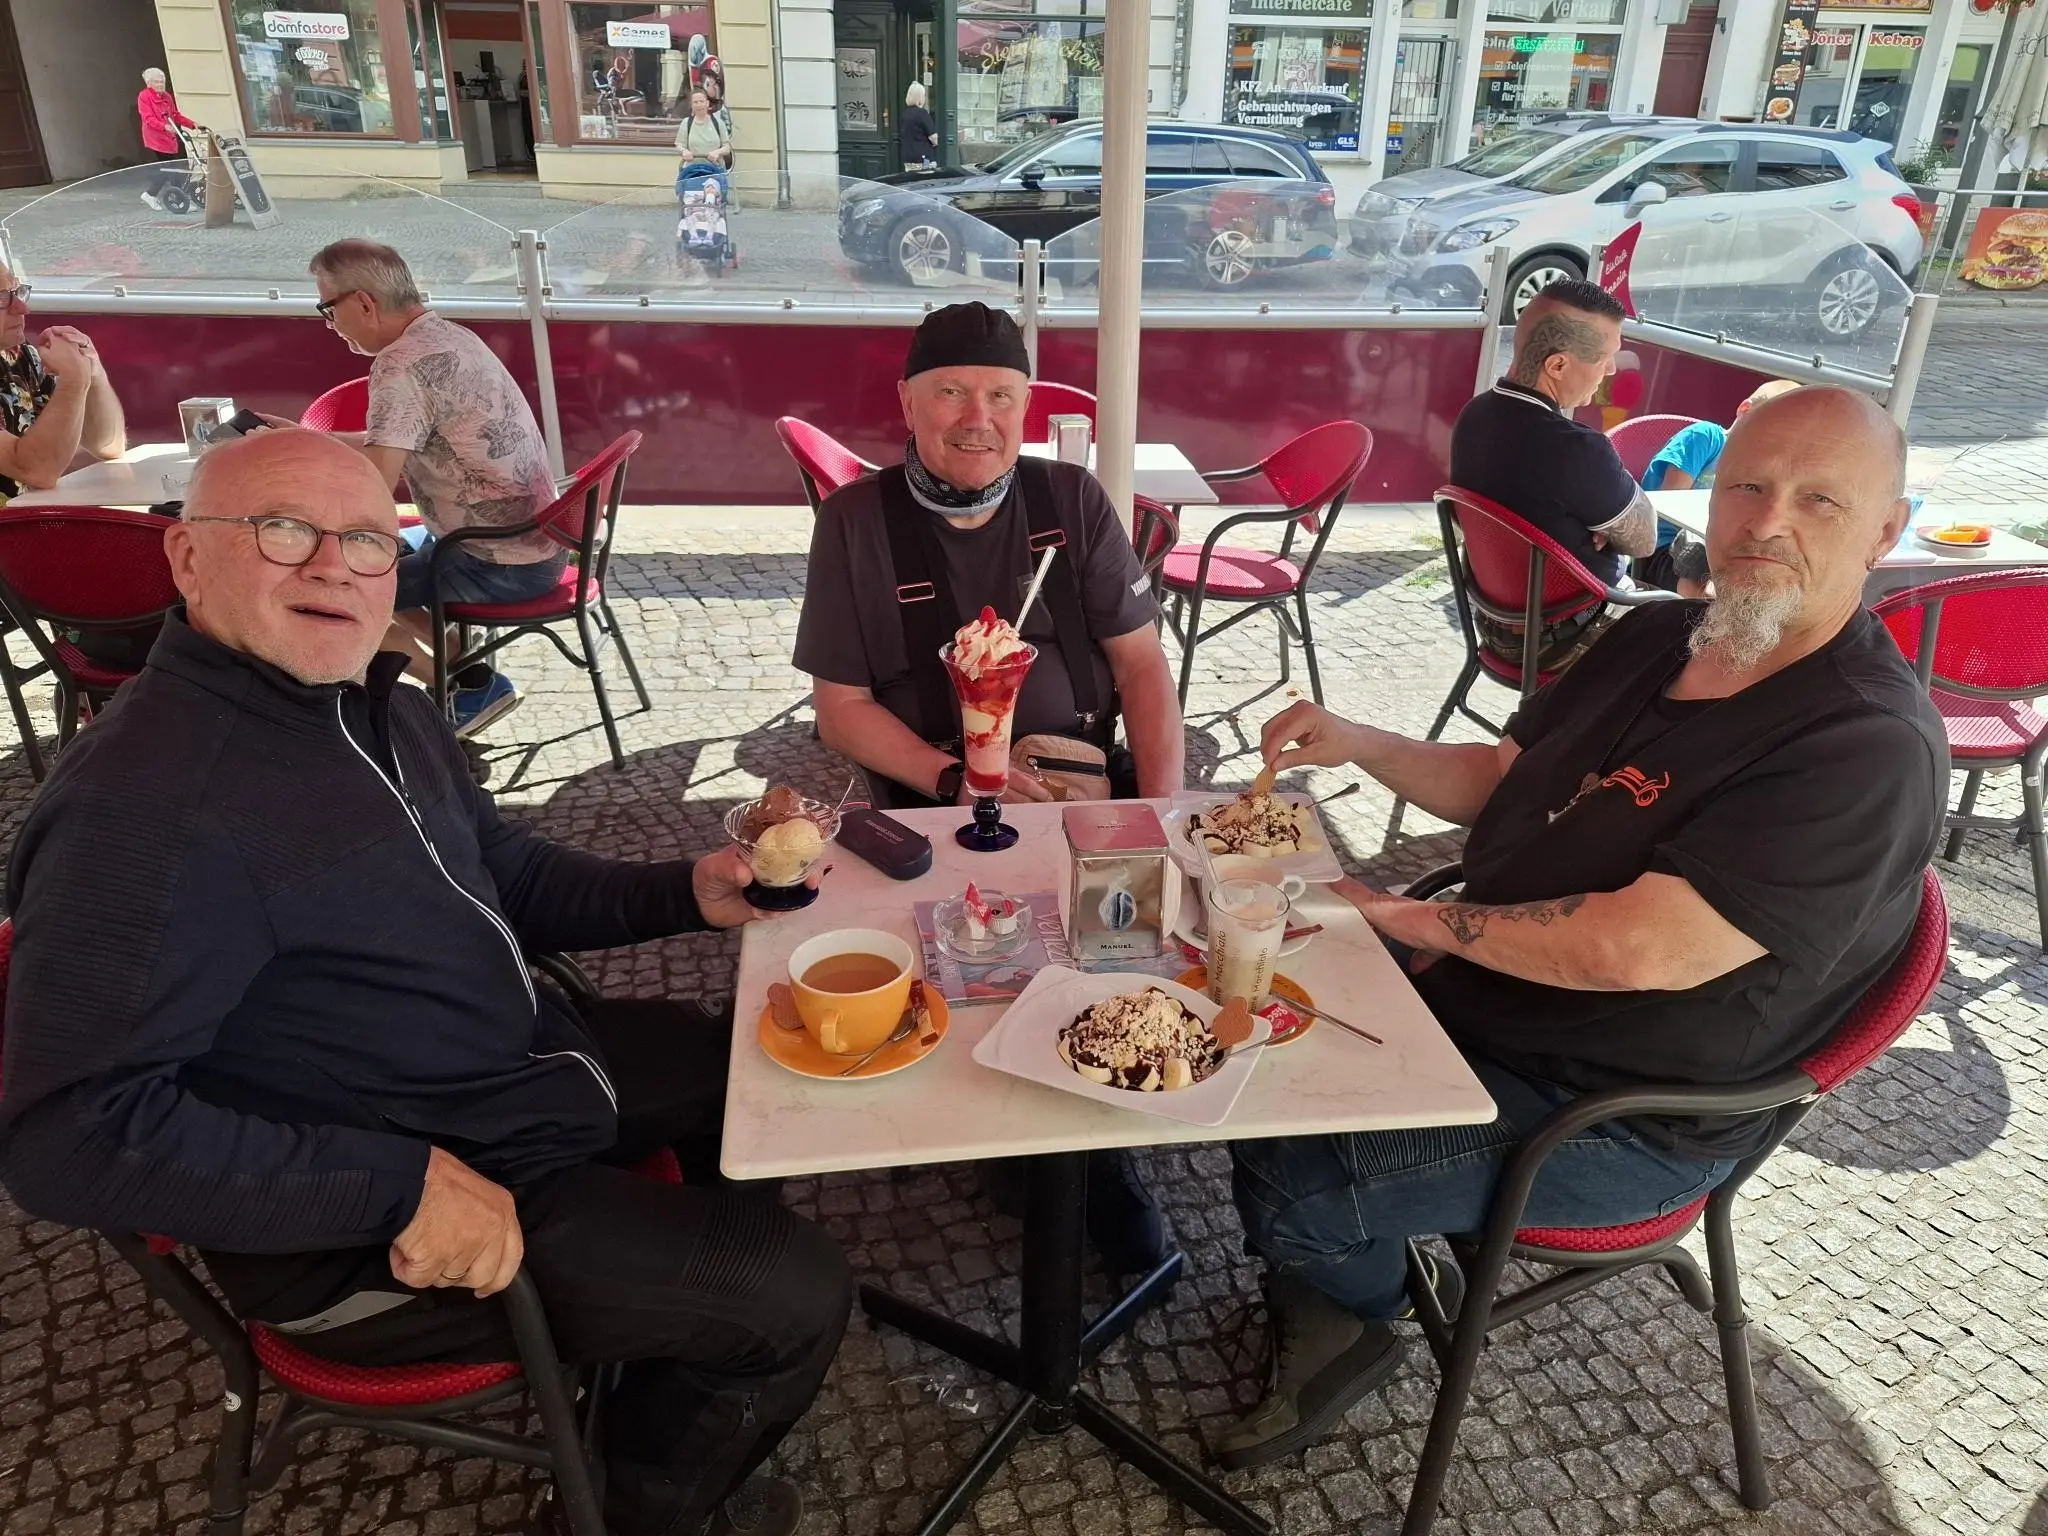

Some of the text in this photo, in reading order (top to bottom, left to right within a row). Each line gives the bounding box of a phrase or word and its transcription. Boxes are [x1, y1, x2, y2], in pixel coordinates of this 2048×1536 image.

[267, 19, 347, 35] damfastore
[1868, 32, 1925, 49] Kebap
[1240, 80, 1262, 93] KFZ
[1303, 82, 1350, 95] Verkauf
[1501, 92, 1515, 101] für
[1238, 100, 1332, 116] Gebrauchtwagen
[1237, 113, 1304, 128] Vermittlung
[1337, 136, 1355, 145] GLS
[1215, 930, 1226, 983] Macchiato
